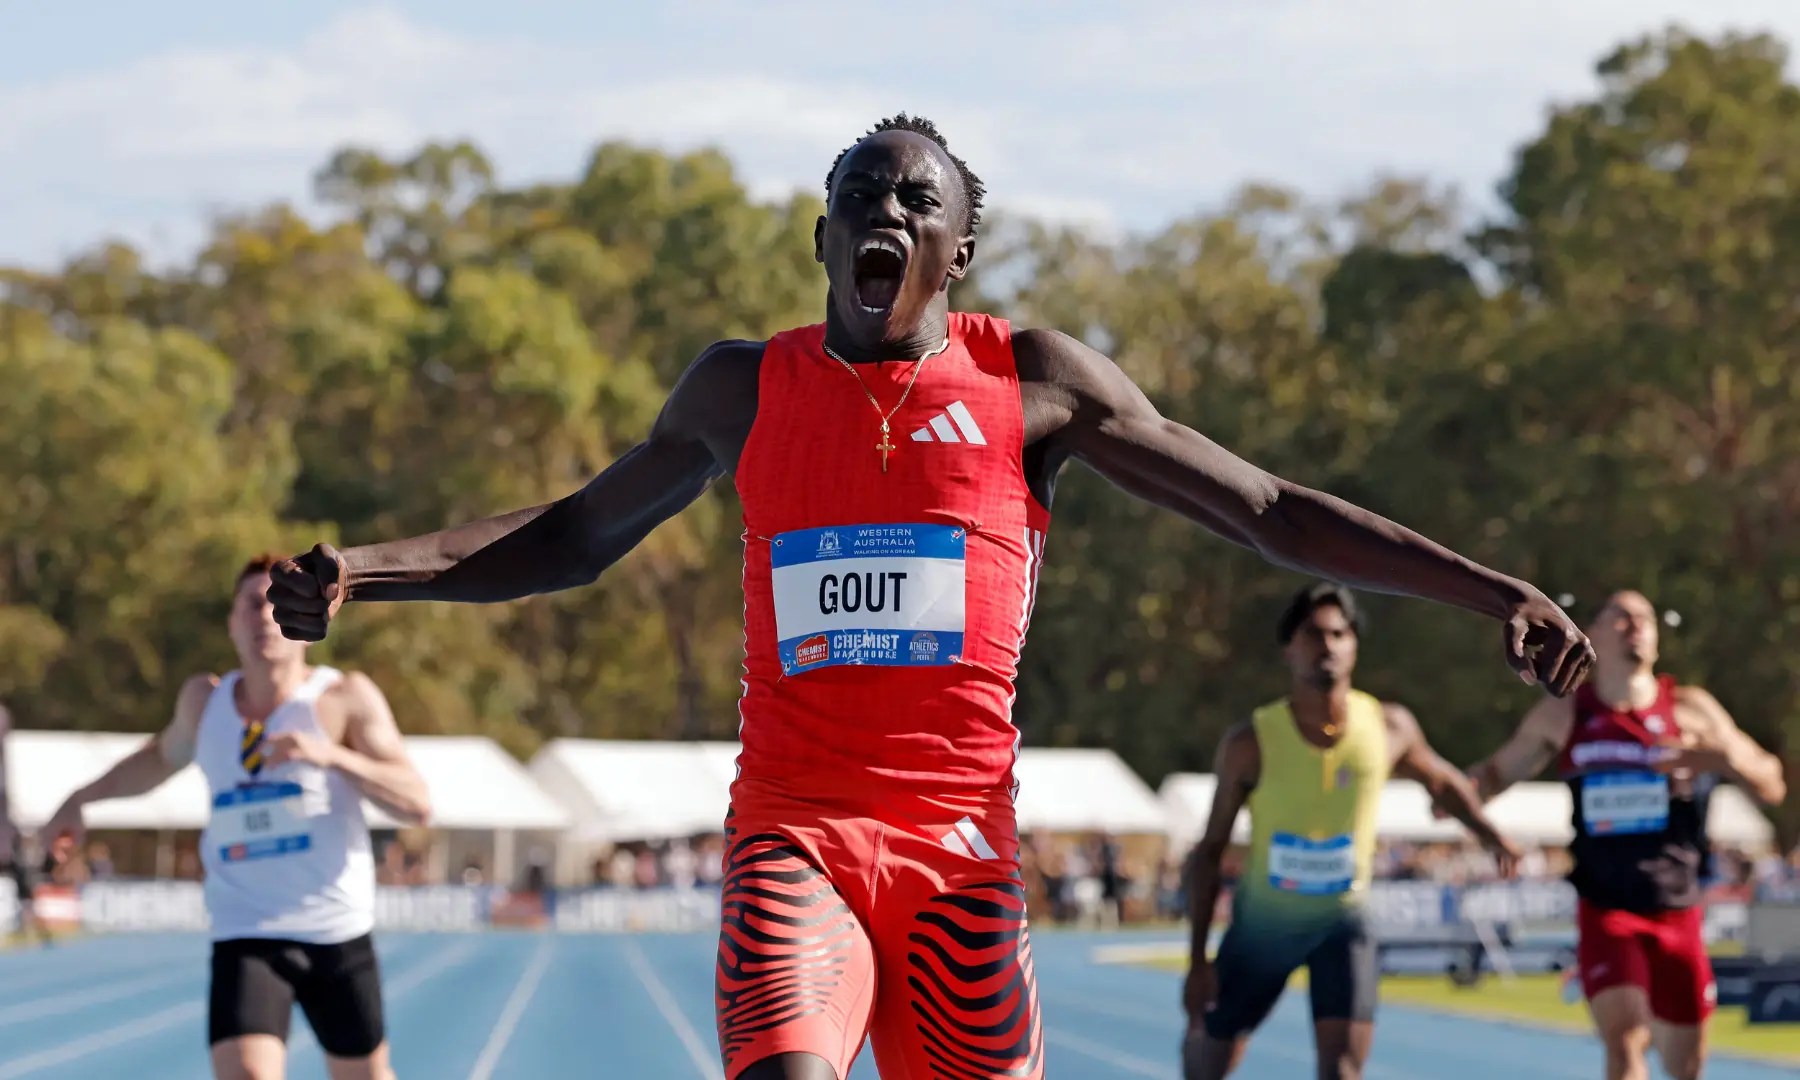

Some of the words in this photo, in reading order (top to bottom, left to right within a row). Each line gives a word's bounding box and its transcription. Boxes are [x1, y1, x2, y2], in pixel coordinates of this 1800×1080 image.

[858, 529, 912, 537] WESTERN
[853, 538, 916, 547] AUSTRALIA
[819, 572, 907, 615] GOUT
[833, 634, 899, 649] CHEMIST
[909, 641, 939, 652] ATHLETICS
[798, 643, 827, 657] CHEMIST
